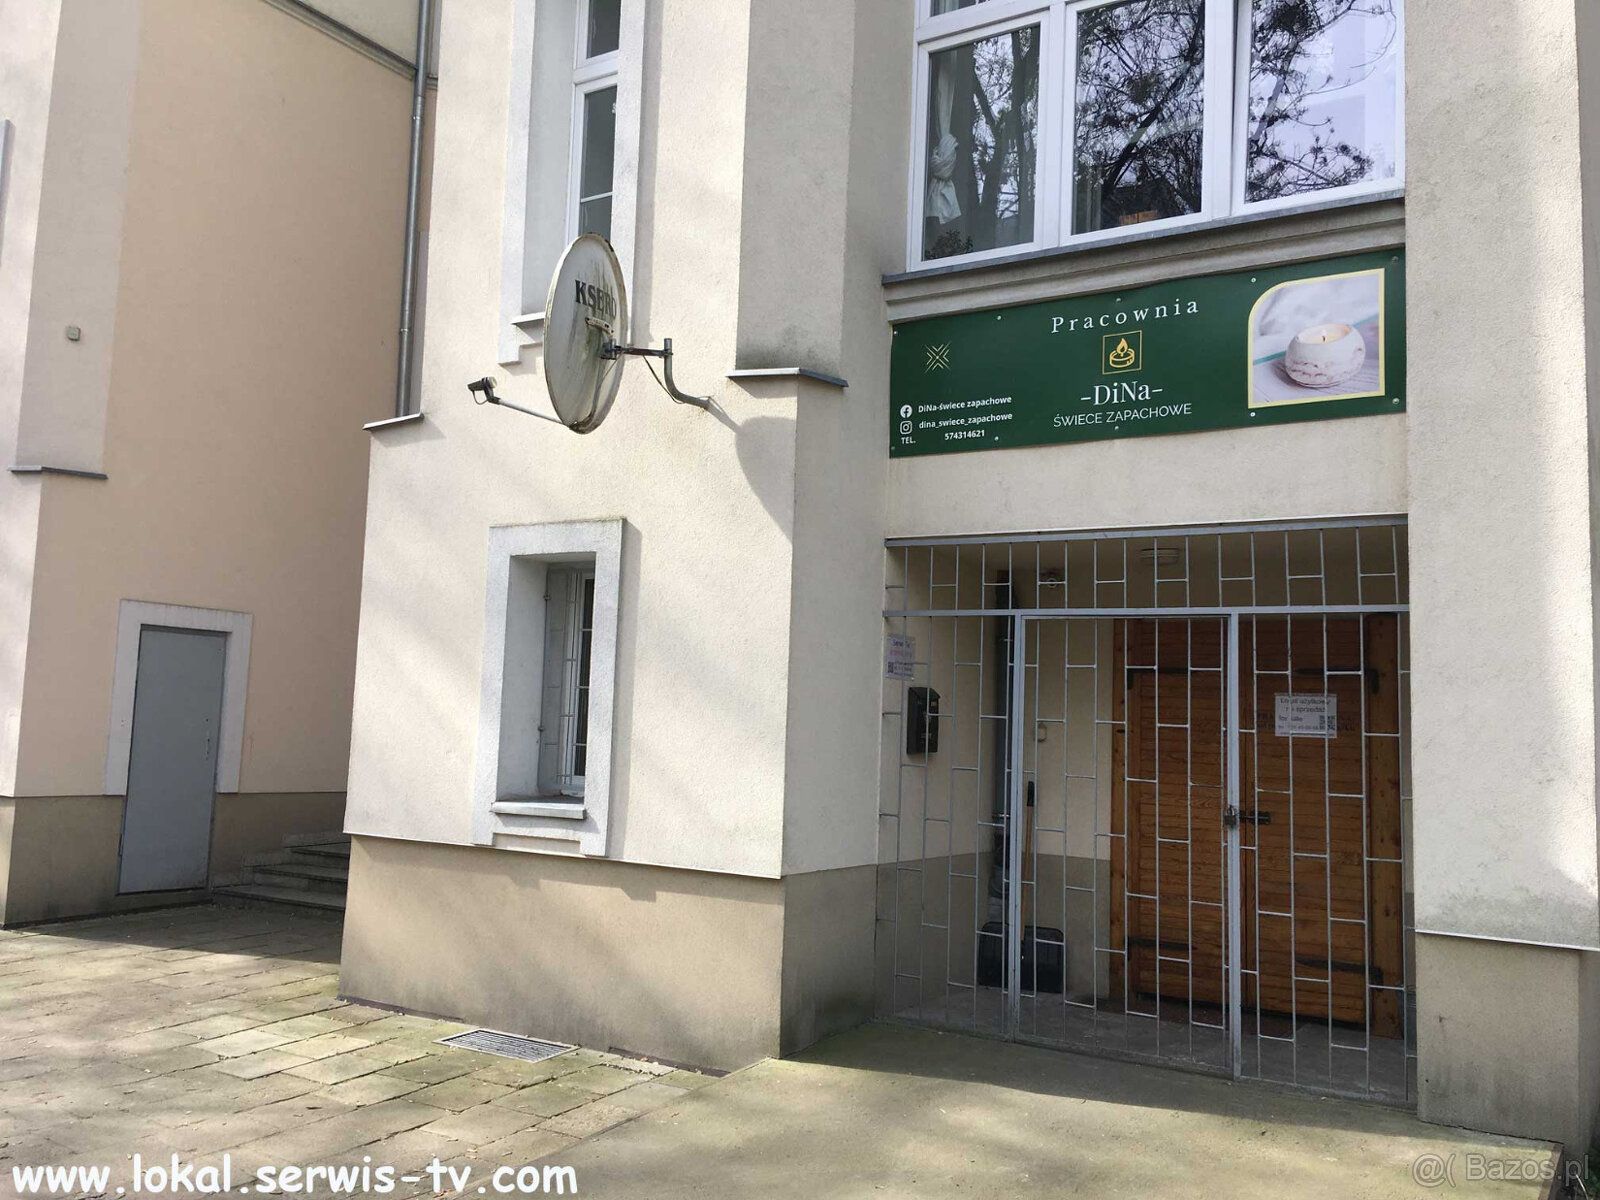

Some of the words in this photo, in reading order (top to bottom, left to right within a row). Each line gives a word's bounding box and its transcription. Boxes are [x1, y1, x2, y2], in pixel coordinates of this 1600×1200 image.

[1051, 298, 1199, 333] Pracownia
[966, 396, 1012, 410] zapachowe
[1053, 411, 1103, 428] ŚWIECE
[1106, 403, 1193, 423] ZAPACHOWE
[901, 436, 917, 445] TEL.
[944, 429, 985, 441] 574314621
